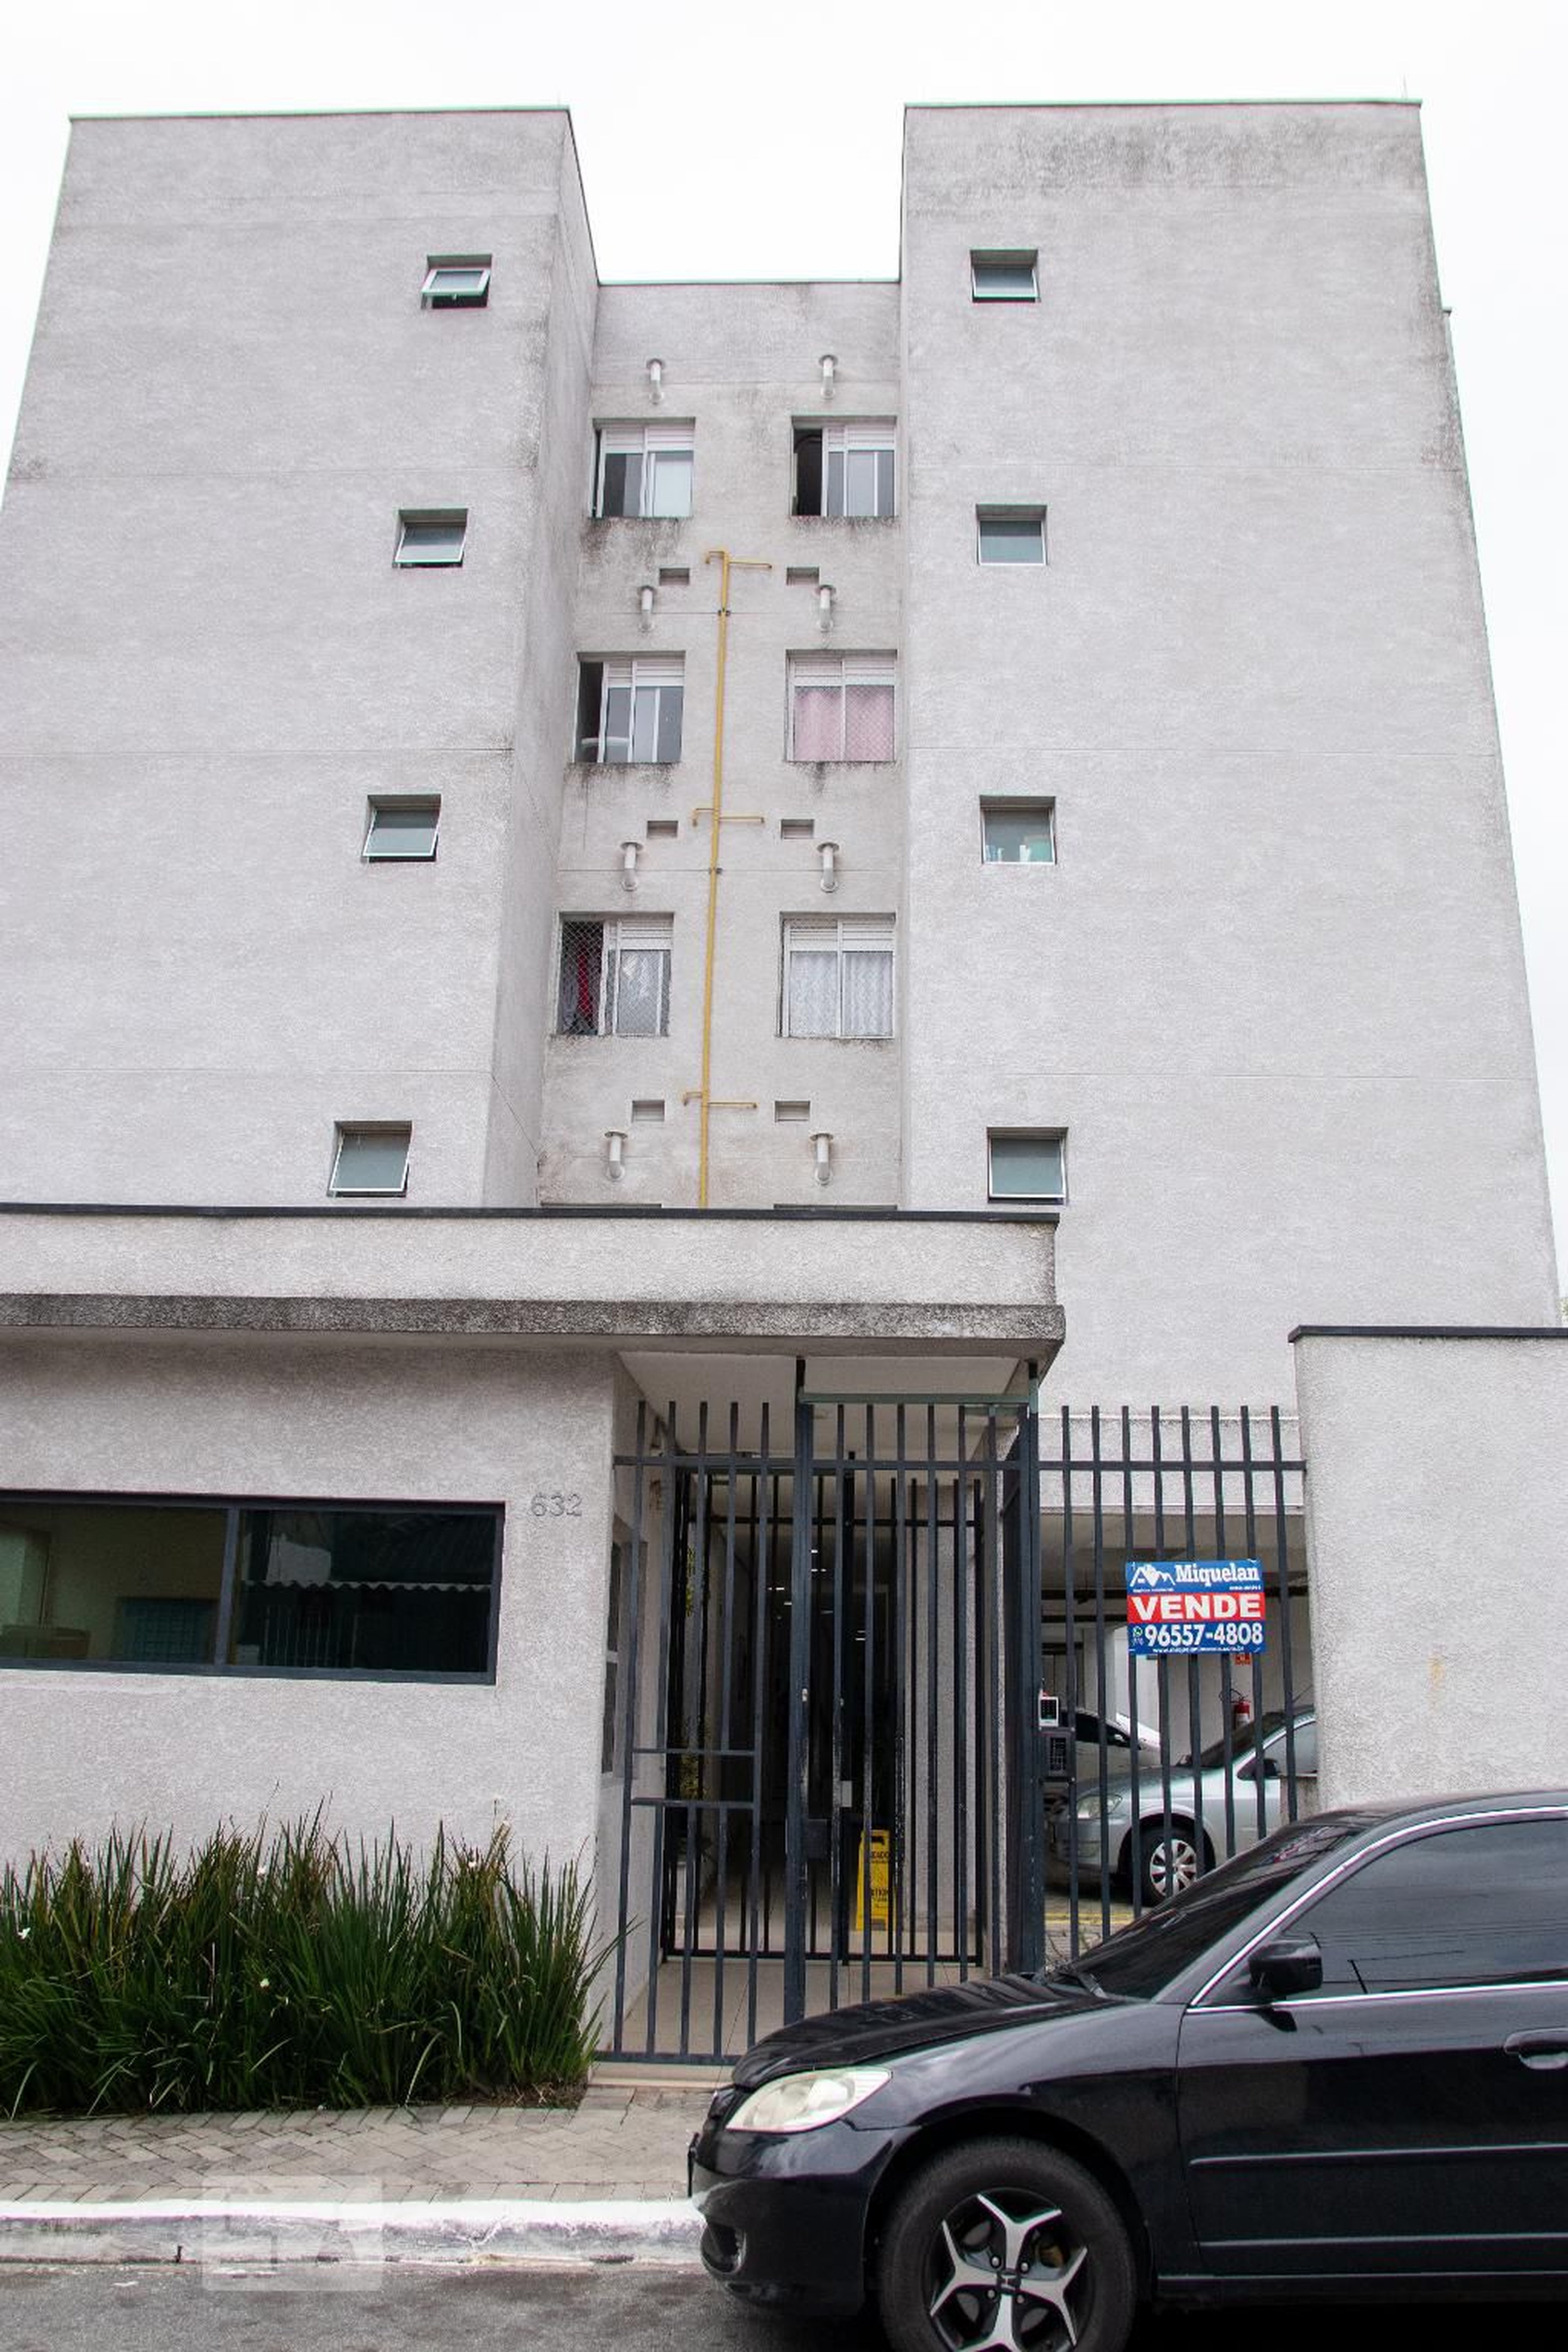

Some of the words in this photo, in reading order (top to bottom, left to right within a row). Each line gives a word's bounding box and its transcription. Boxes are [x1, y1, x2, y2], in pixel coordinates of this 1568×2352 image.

[532, 1493, 582, 1516] 632
[1175, 1563, 1260, 1586] Miquelan
[1131, 1594, 1261, 1621] VENDE
[1145, 1622, 1263, 1647] 96557-4808
